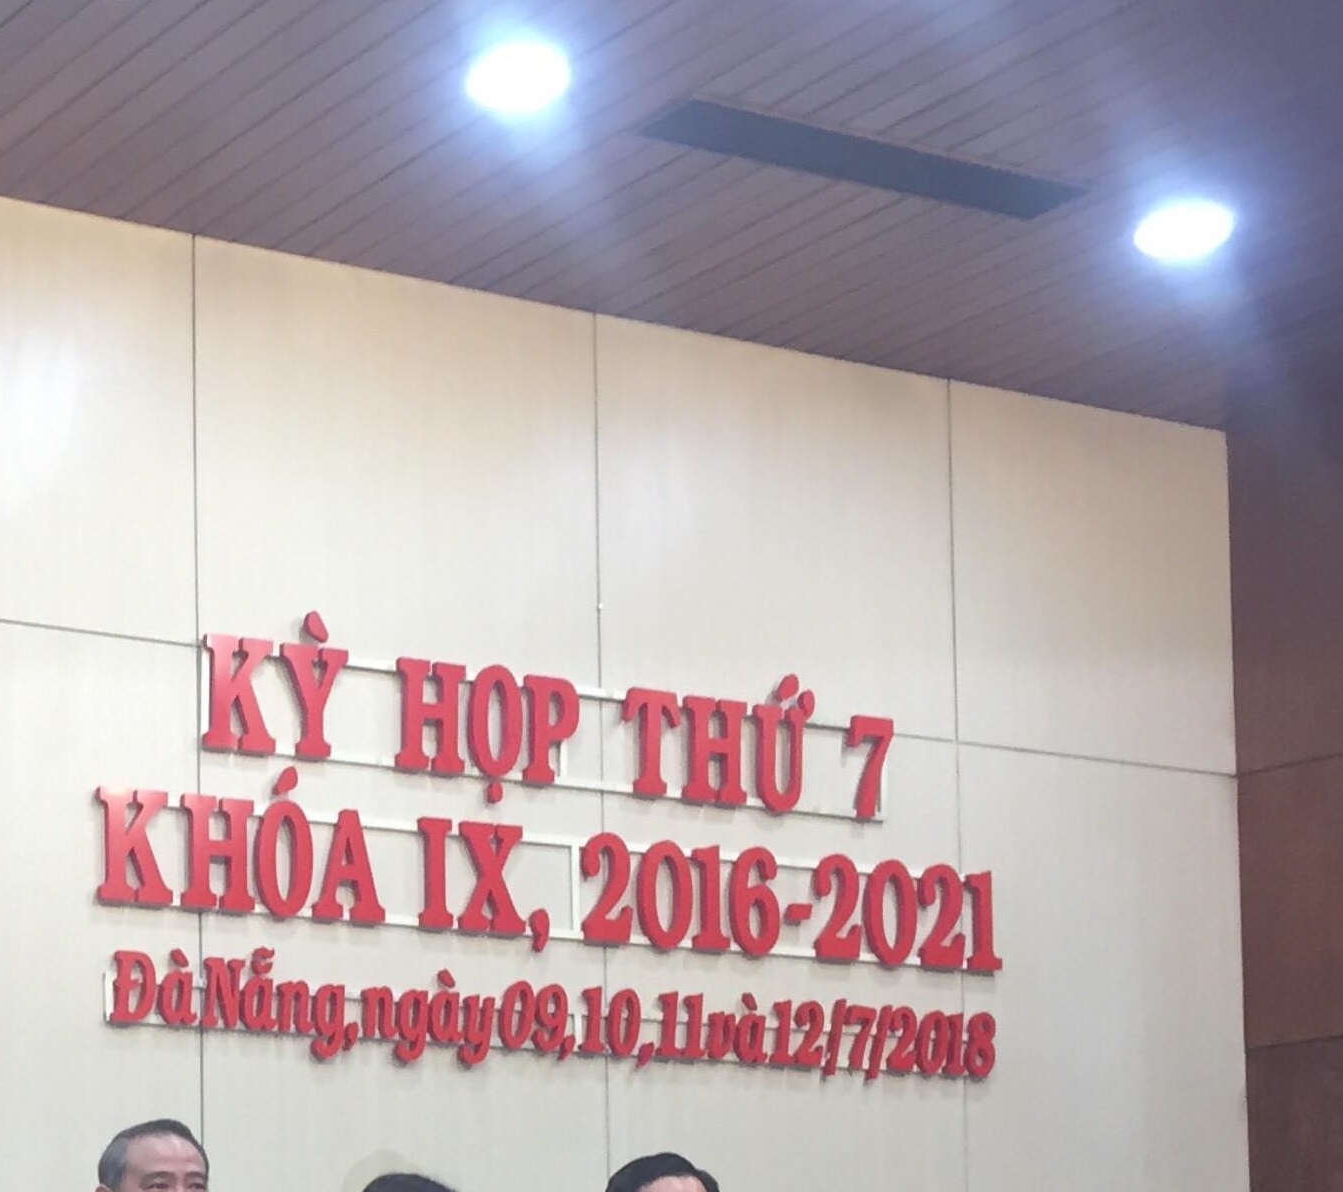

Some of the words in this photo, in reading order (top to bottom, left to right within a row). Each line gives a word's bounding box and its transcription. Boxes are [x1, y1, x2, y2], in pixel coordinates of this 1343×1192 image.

[202, 612, 349, 758] KỲ
[396, 657, 580, 803] HỌP
[621, 674, 816, 813] THỨ
[845, 714, 894, 820] 7
[95, 766, 386, 924] KHÓA
[417, 816, 550, 951] IX,
[580, 831, 1003, 972] 2016-2021
[110, 948, 197, 1025] Đà
